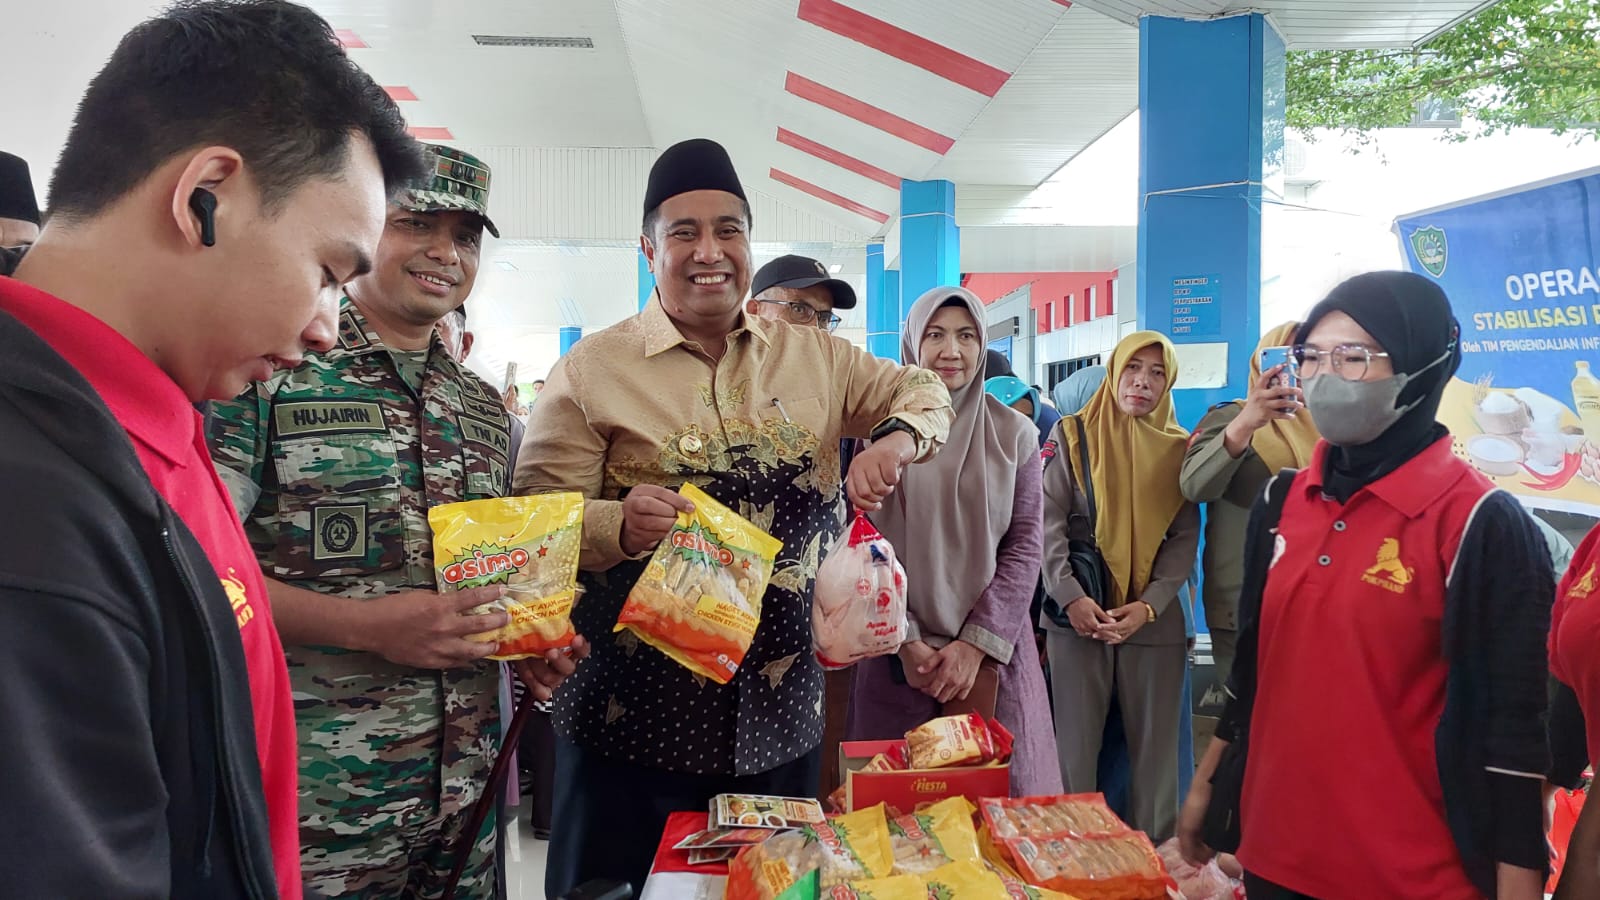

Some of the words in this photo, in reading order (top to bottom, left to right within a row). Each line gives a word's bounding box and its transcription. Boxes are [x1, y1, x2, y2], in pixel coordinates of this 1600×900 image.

[1505, 266, 1600, 301] OPERA
[1473, 305, 1588, 331] STABILISASI
[1461, 341, 1481, 353] Oleh
[1481, 341, 1499, 352] TIM
[1500, 338, 1578, 352] PENGENDALIAN
[292, 408, 370, 426] HUJAIRIN
[470, 424, 492, 442] TNI
[671, 529, 734, 566] asimo
[443, 548, 529, 584] asimo
[916, 781, 947, 793] FIESTA
